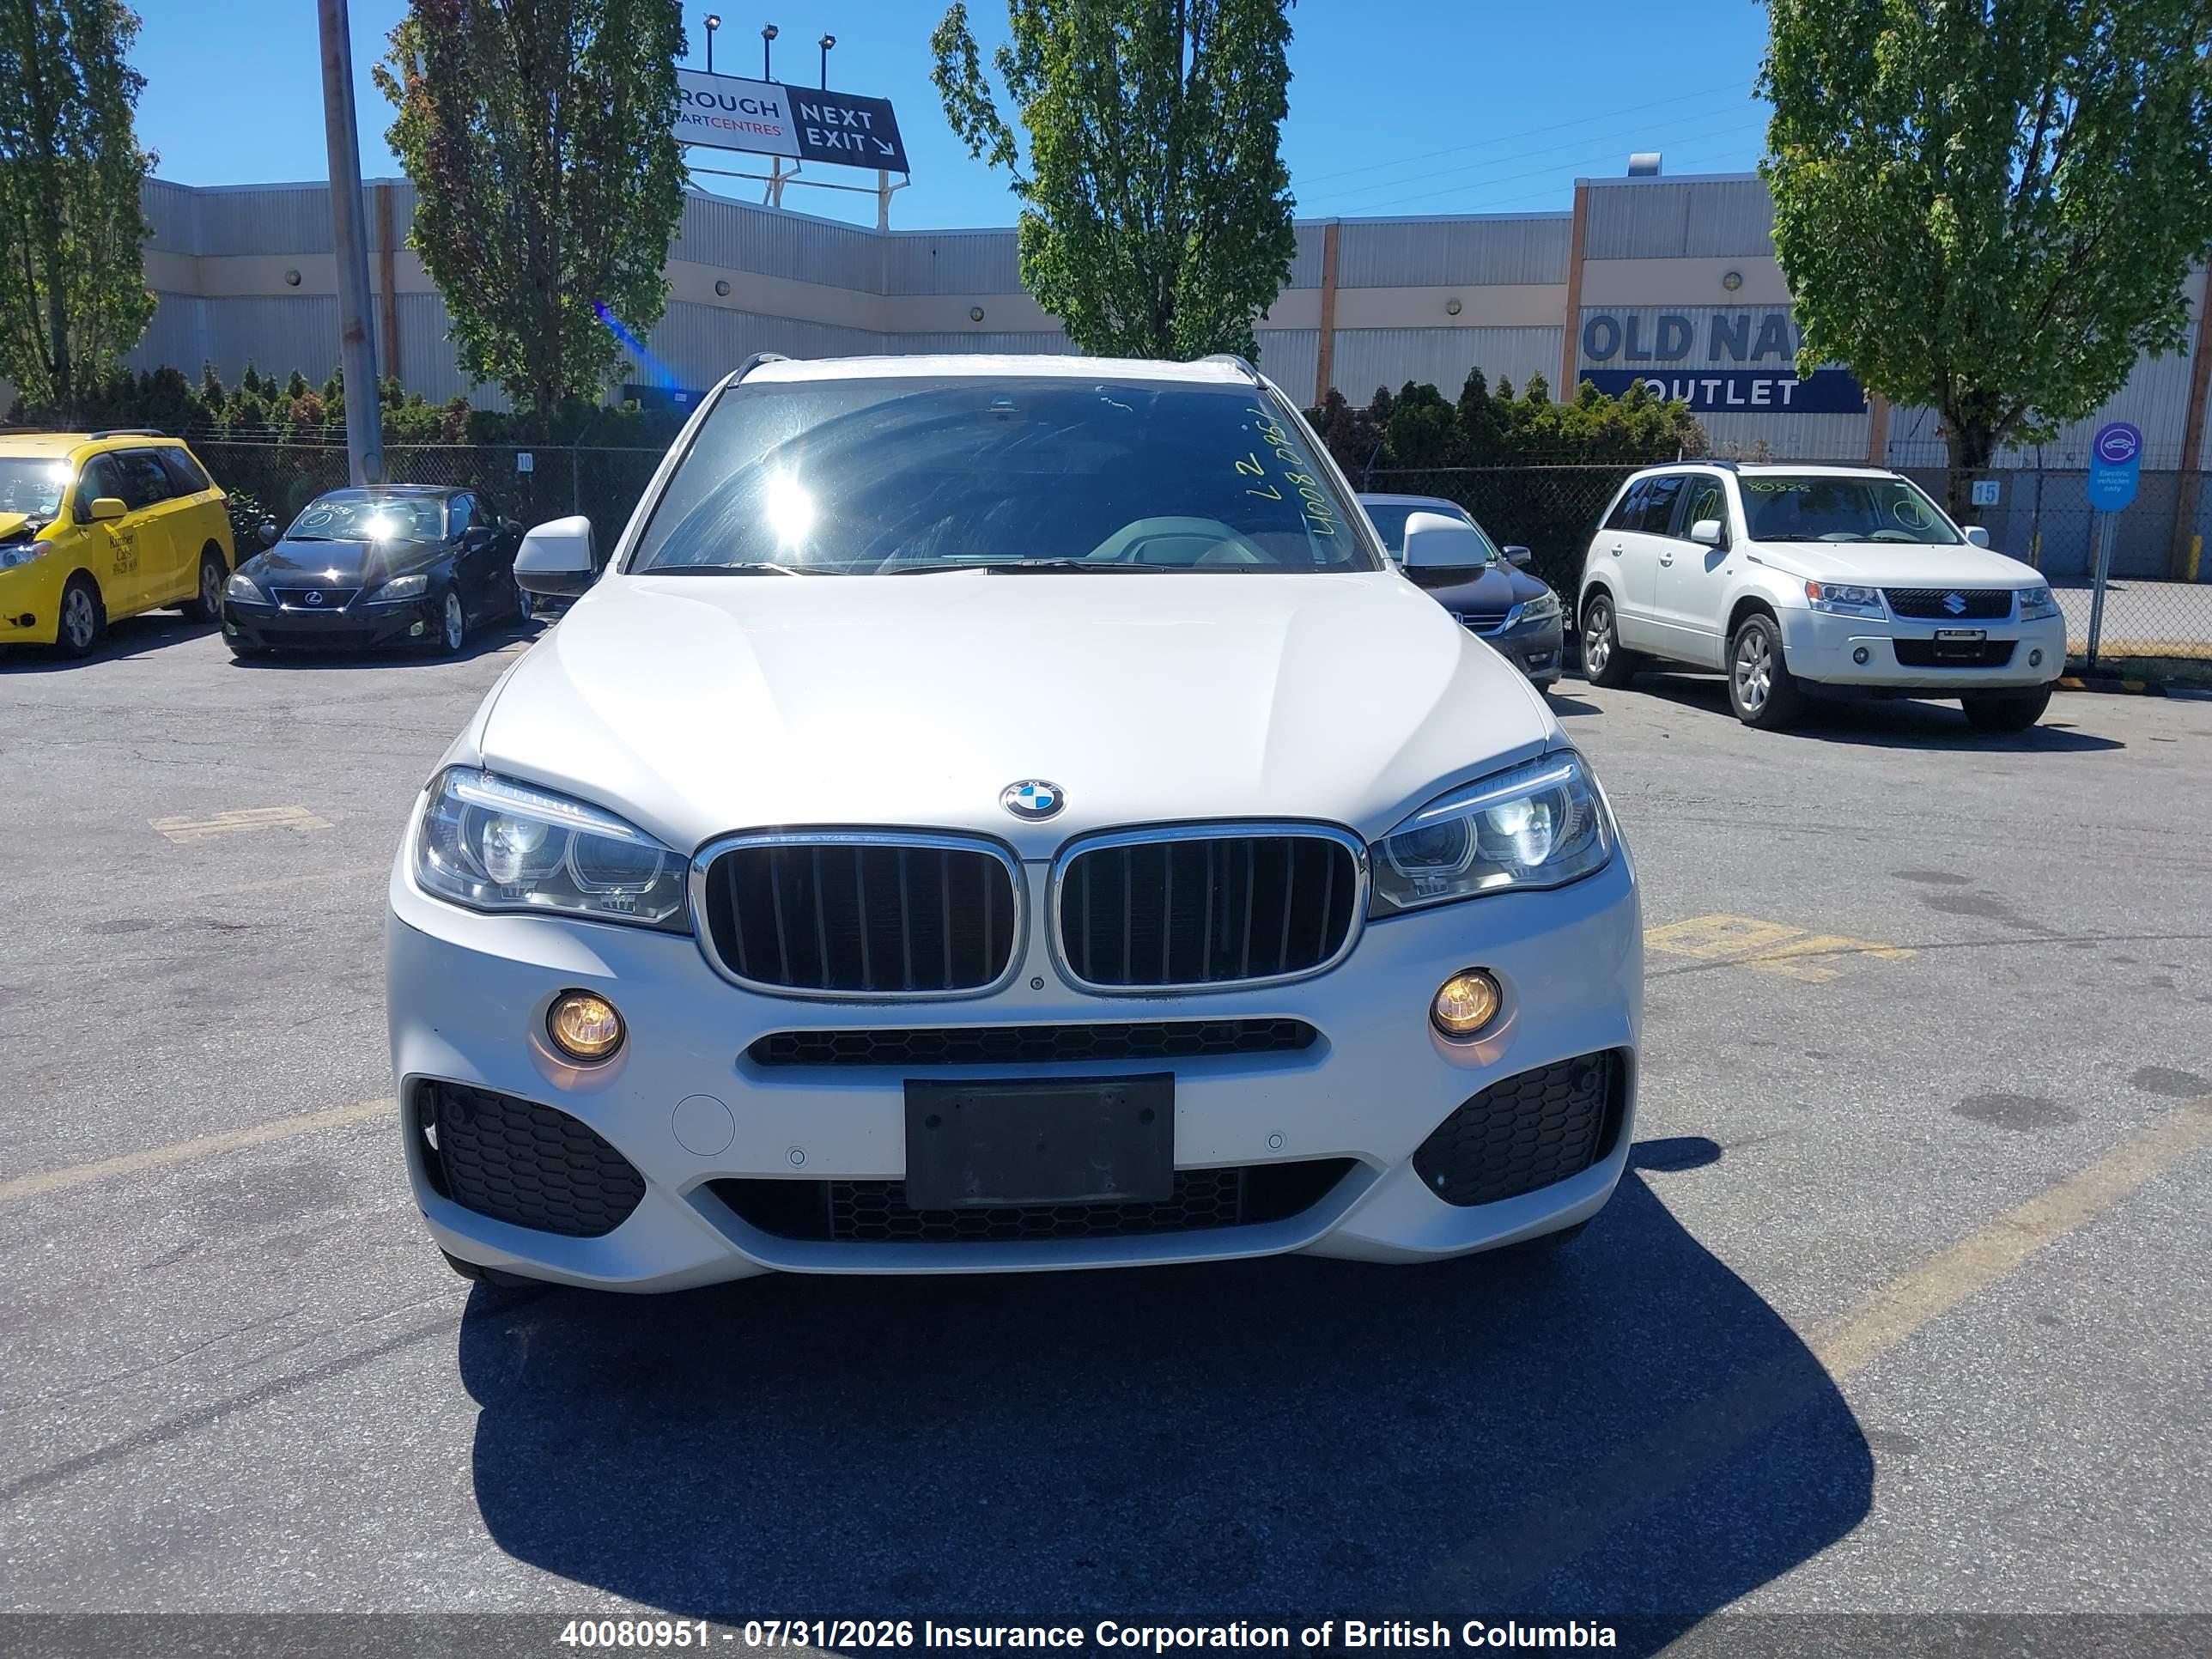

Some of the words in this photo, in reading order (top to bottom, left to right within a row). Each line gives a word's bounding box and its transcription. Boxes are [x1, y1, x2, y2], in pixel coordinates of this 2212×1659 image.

[677, 113, 782, 137] ARTCENTRES
[800, 102, 872, 130] NEXT
[806, 127, 866, 152] EXIT
[1583, 314, 1694, 362] OLD
[1708, 313, 1808, 362] NA
[1642, 379, 1800, 405] OUTLET
[519, 455, 532, 470] 10
[1976, 484, 1996, 502] 15
